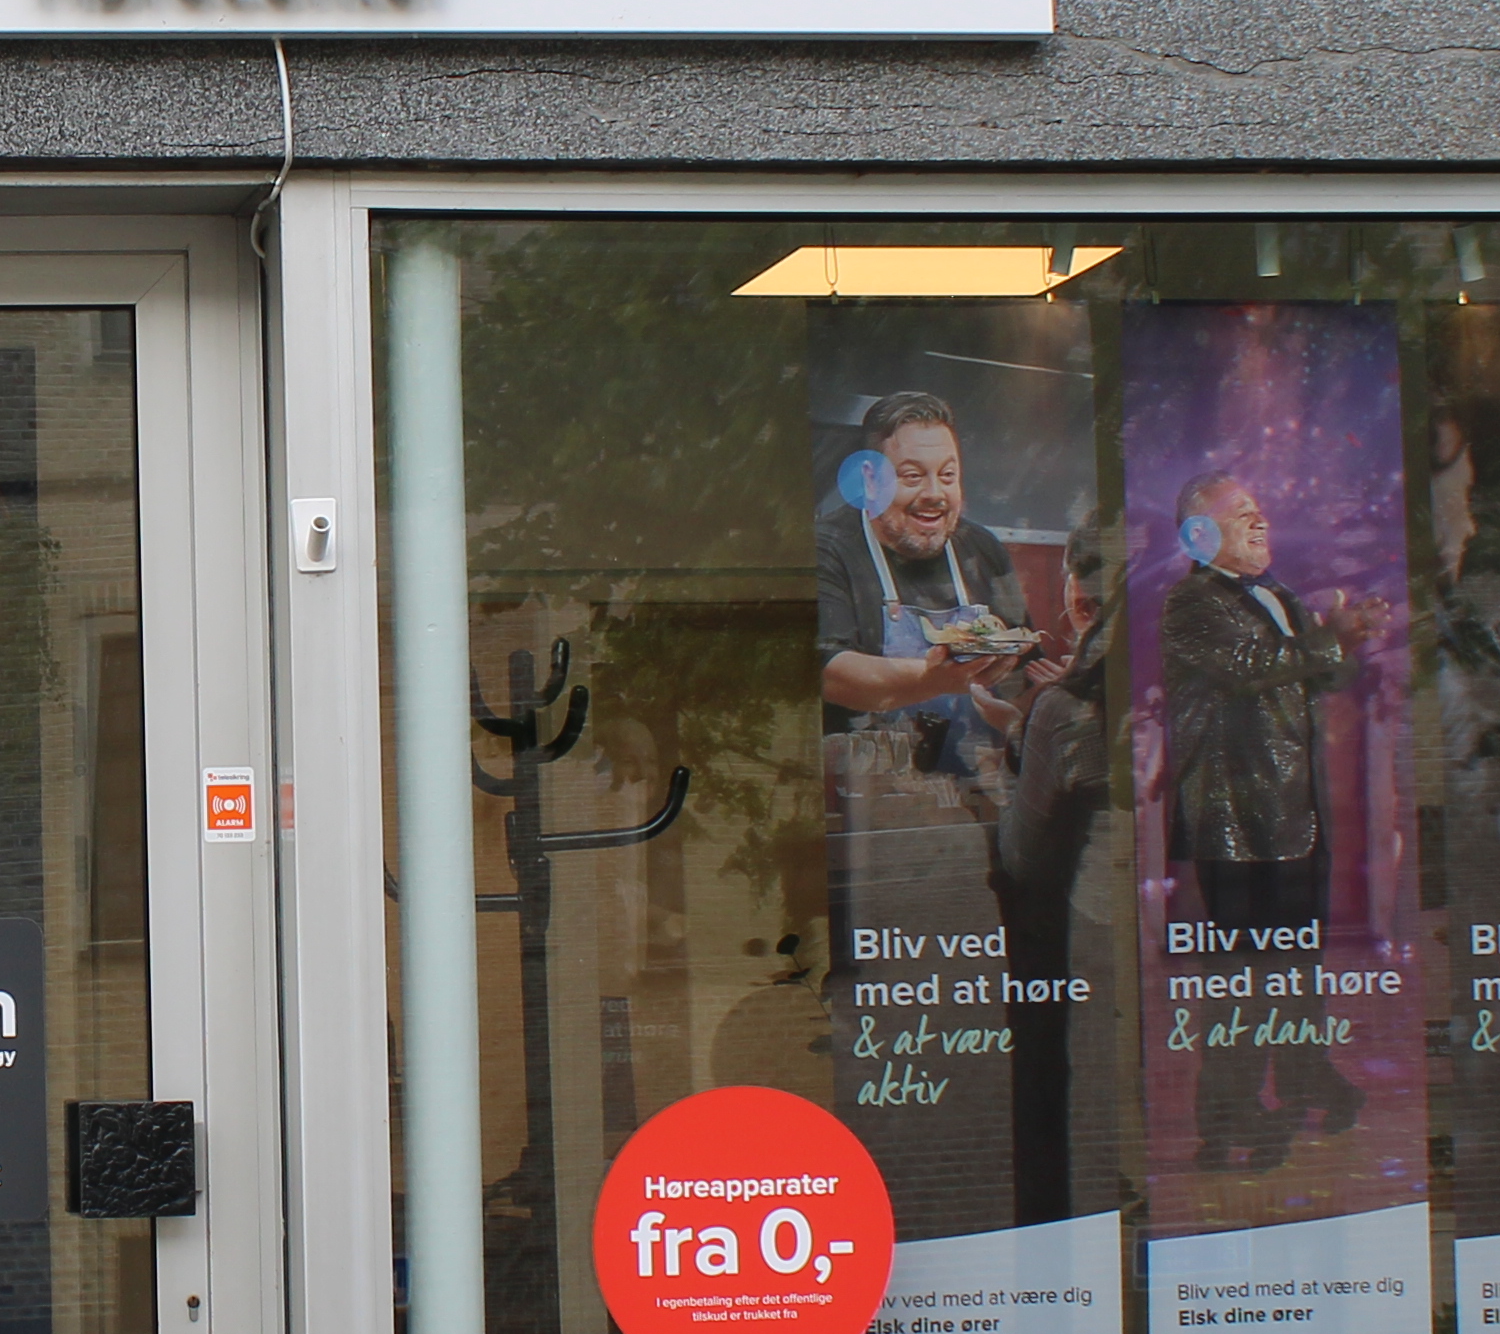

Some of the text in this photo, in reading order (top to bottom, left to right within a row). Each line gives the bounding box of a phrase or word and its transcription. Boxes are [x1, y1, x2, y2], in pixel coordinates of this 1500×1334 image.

[853, 926, 1006, 959] Bliv ved
[1168, 919, 1320, 954] Bliv ved
[855, 972, 1091, 1007] med at høre
[1169, 965, 1402, 1000] med at høre
[853, 1014, 1015, 1059] & at være
[1167, 1006, 1354, 1051] & at danse
[1471, 1009, 1500, 1052] &
[857, 1061, 949, 1107] aktiv
[644, 1173, 839, 1202] Høreapparater
[630, 1207, 855, 1284] fra 0,-
[662, 1293, 833, 1309] egenbetaling efter det offentlige
[902, 1287, 1092, 1308] ved med at være dig
[1178, 1277, 1404, 1300] Bliv ved med at være dig
[692, 1309, 798, 1322] tilskud er trukket fra
[866, 1317, 1000, 1334] Elsk dine ører
[1179, 1307, 1313, 1326] Elsk dine ører
